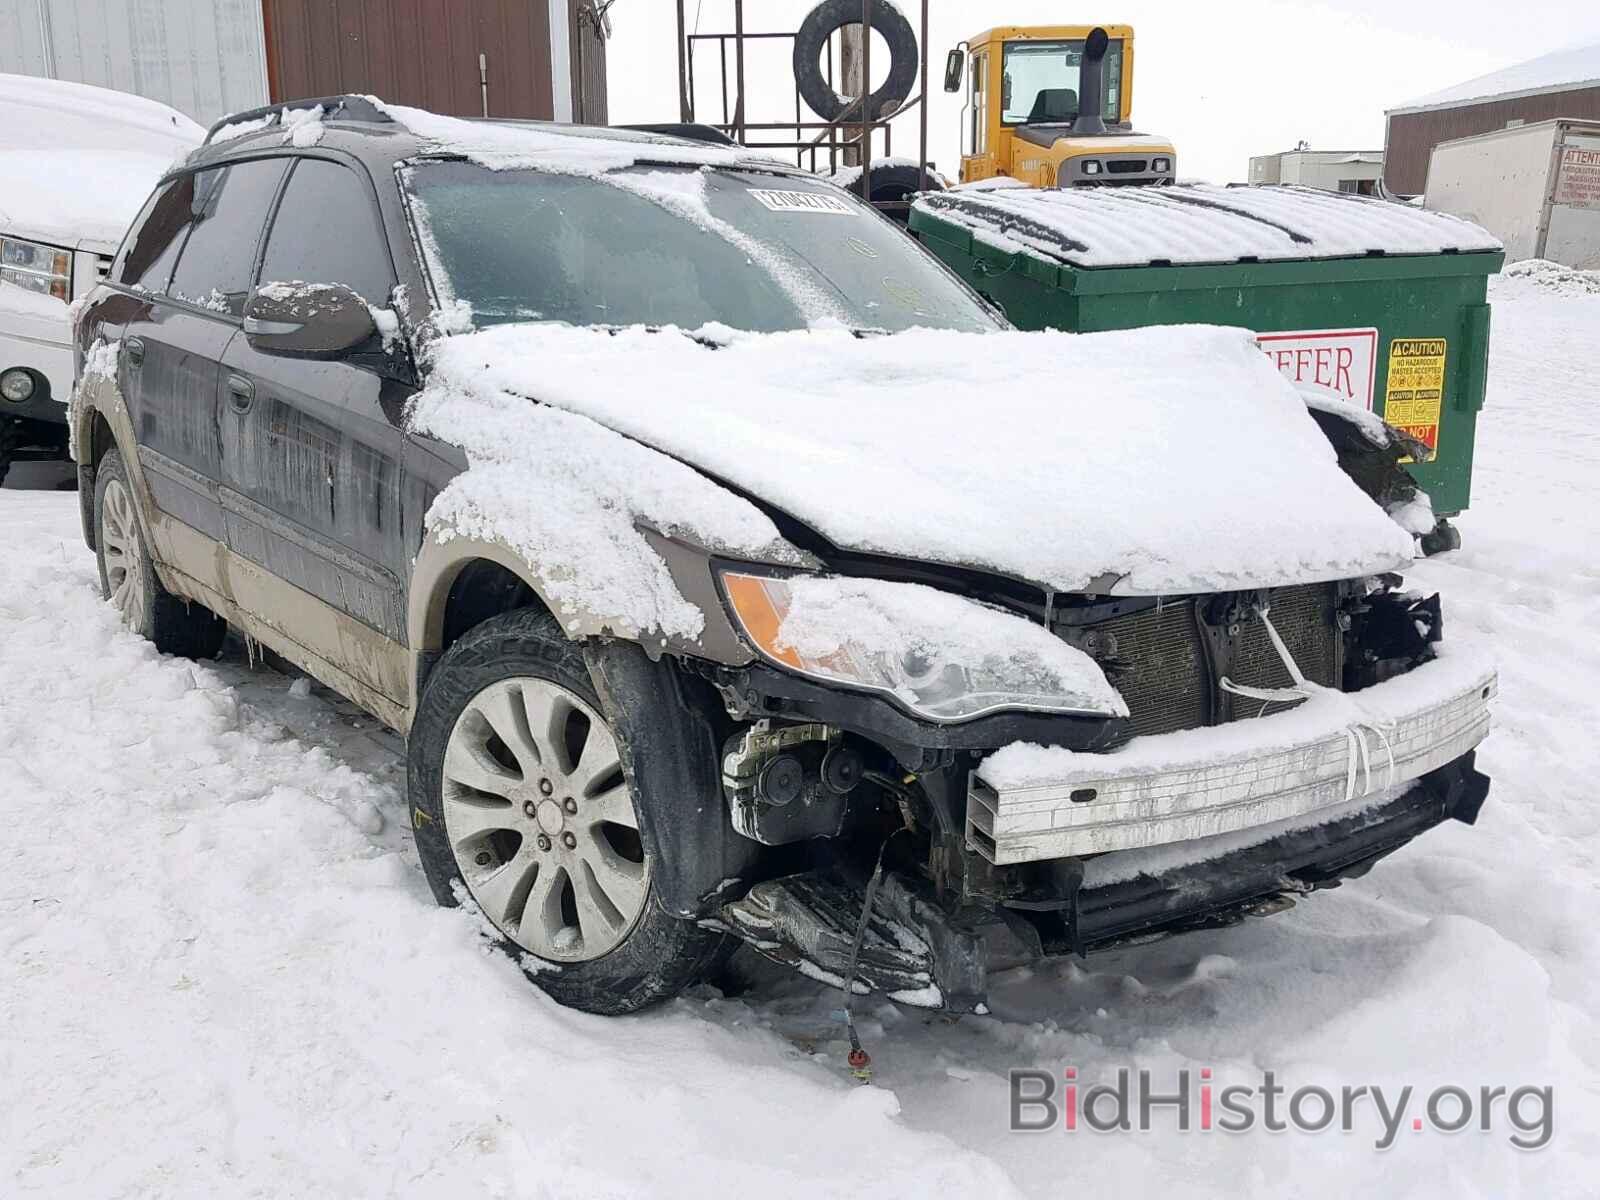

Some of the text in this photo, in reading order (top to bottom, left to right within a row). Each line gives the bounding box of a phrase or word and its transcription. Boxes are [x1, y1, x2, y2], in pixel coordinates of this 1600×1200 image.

[1402, 342, 1444, 356] CAUTION
[1397, 359, 1405, 367] NO
[1265, 347, 1354, 398] FFER
[1409, 426, 1432, 440] NOT
